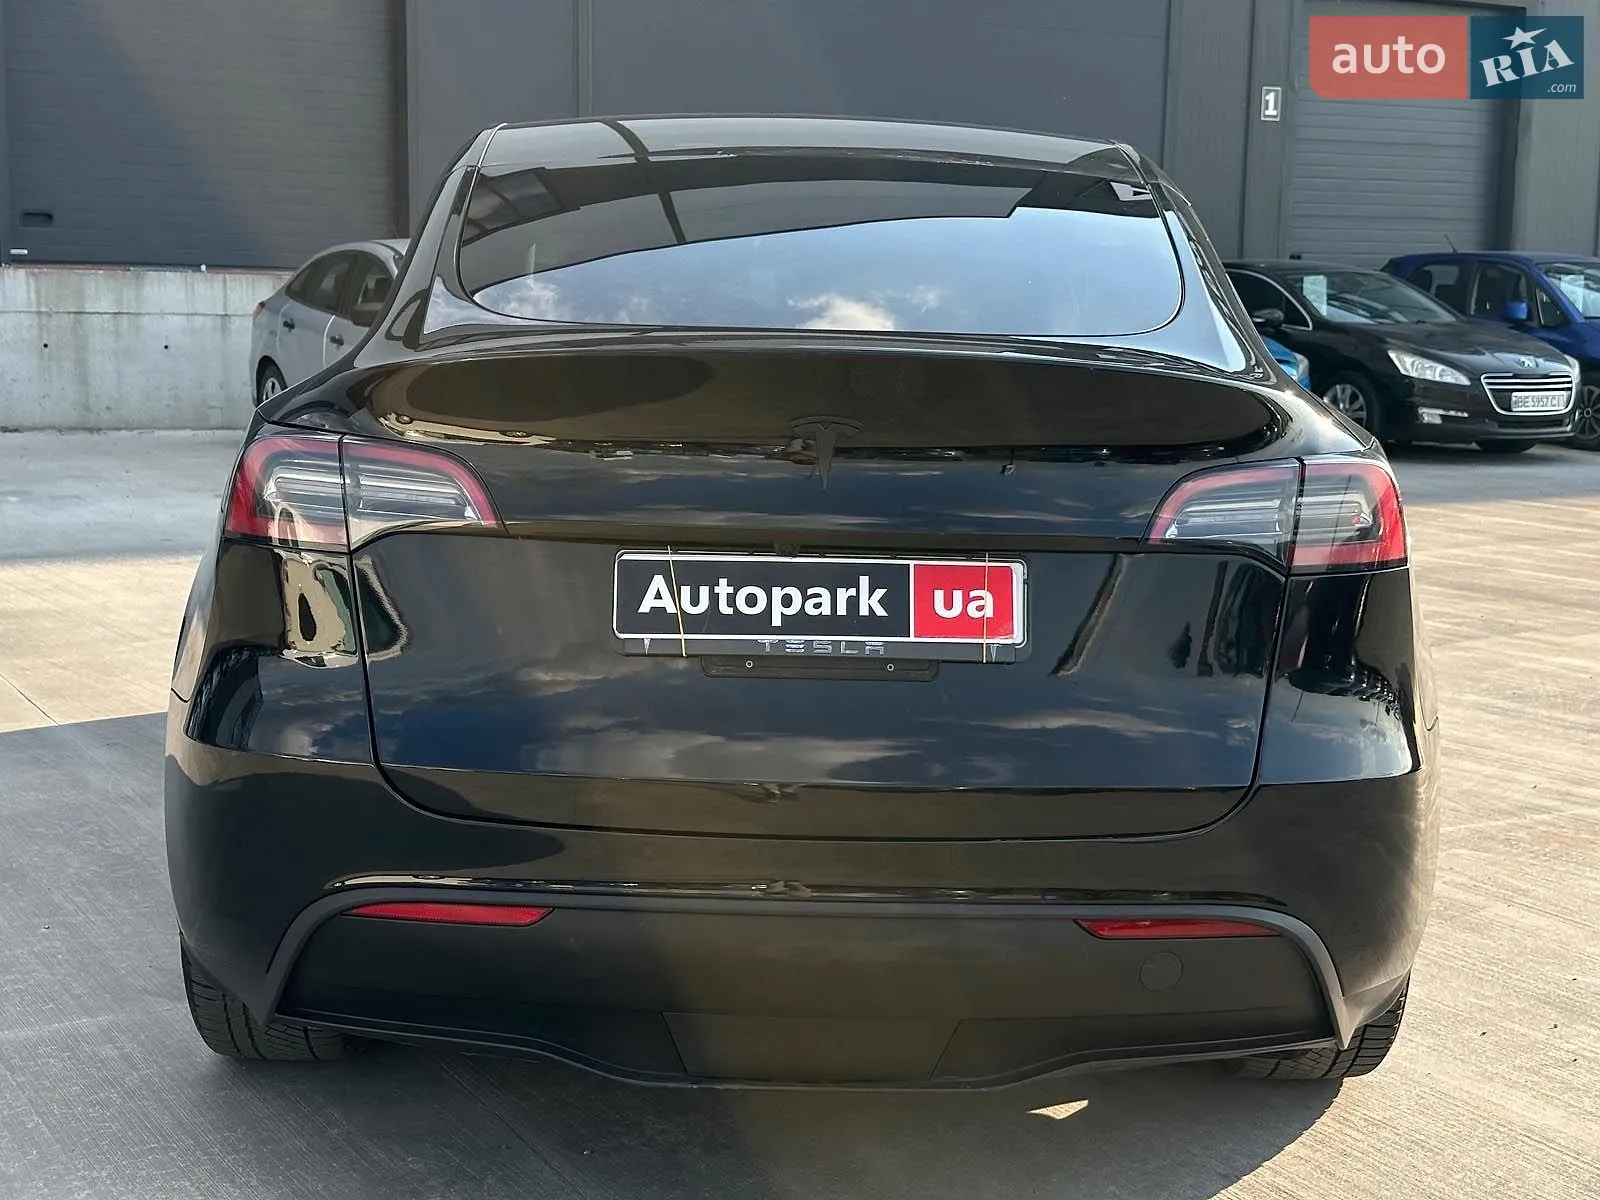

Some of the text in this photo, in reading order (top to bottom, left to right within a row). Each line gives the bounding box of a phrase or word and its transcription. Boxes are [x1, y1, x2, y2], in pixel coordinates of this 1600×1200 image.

[1264, 91, 1277, 116] 1
[637, 574, 995, 627] Autopark ua
[757, 639, 885, 655] TESLA
